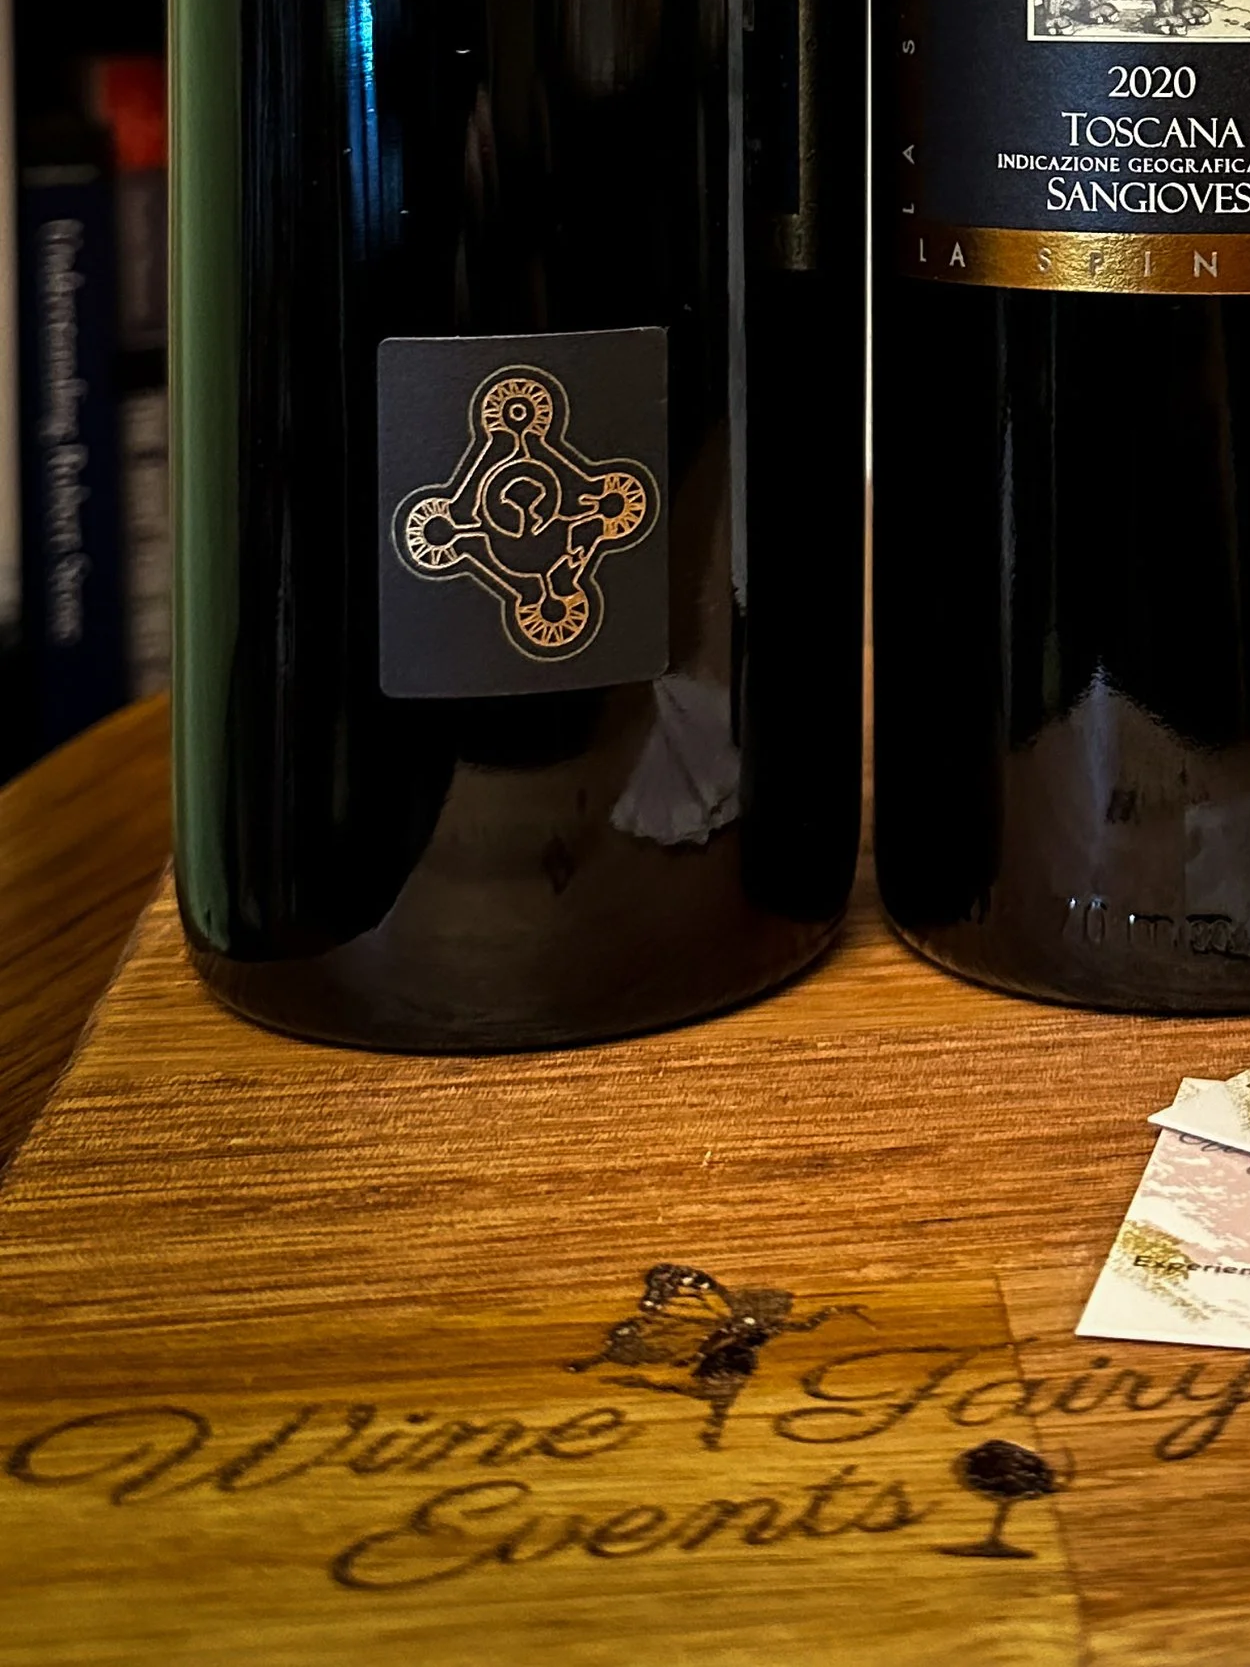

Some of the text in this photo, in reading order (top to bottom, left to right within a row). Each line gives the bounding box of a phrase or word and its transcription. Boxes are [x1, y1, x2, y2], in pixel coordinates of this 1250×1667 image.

[1108, 66, 1197, 99] 2020
[902, 143, 915, 214] LA
[998, 153, 1120, 172] INDICAZIONE
[918, 238, 967, 268] LA
[4, 1399, 648, 1509] Wine
[329, 1458, 938, 1594] Events
